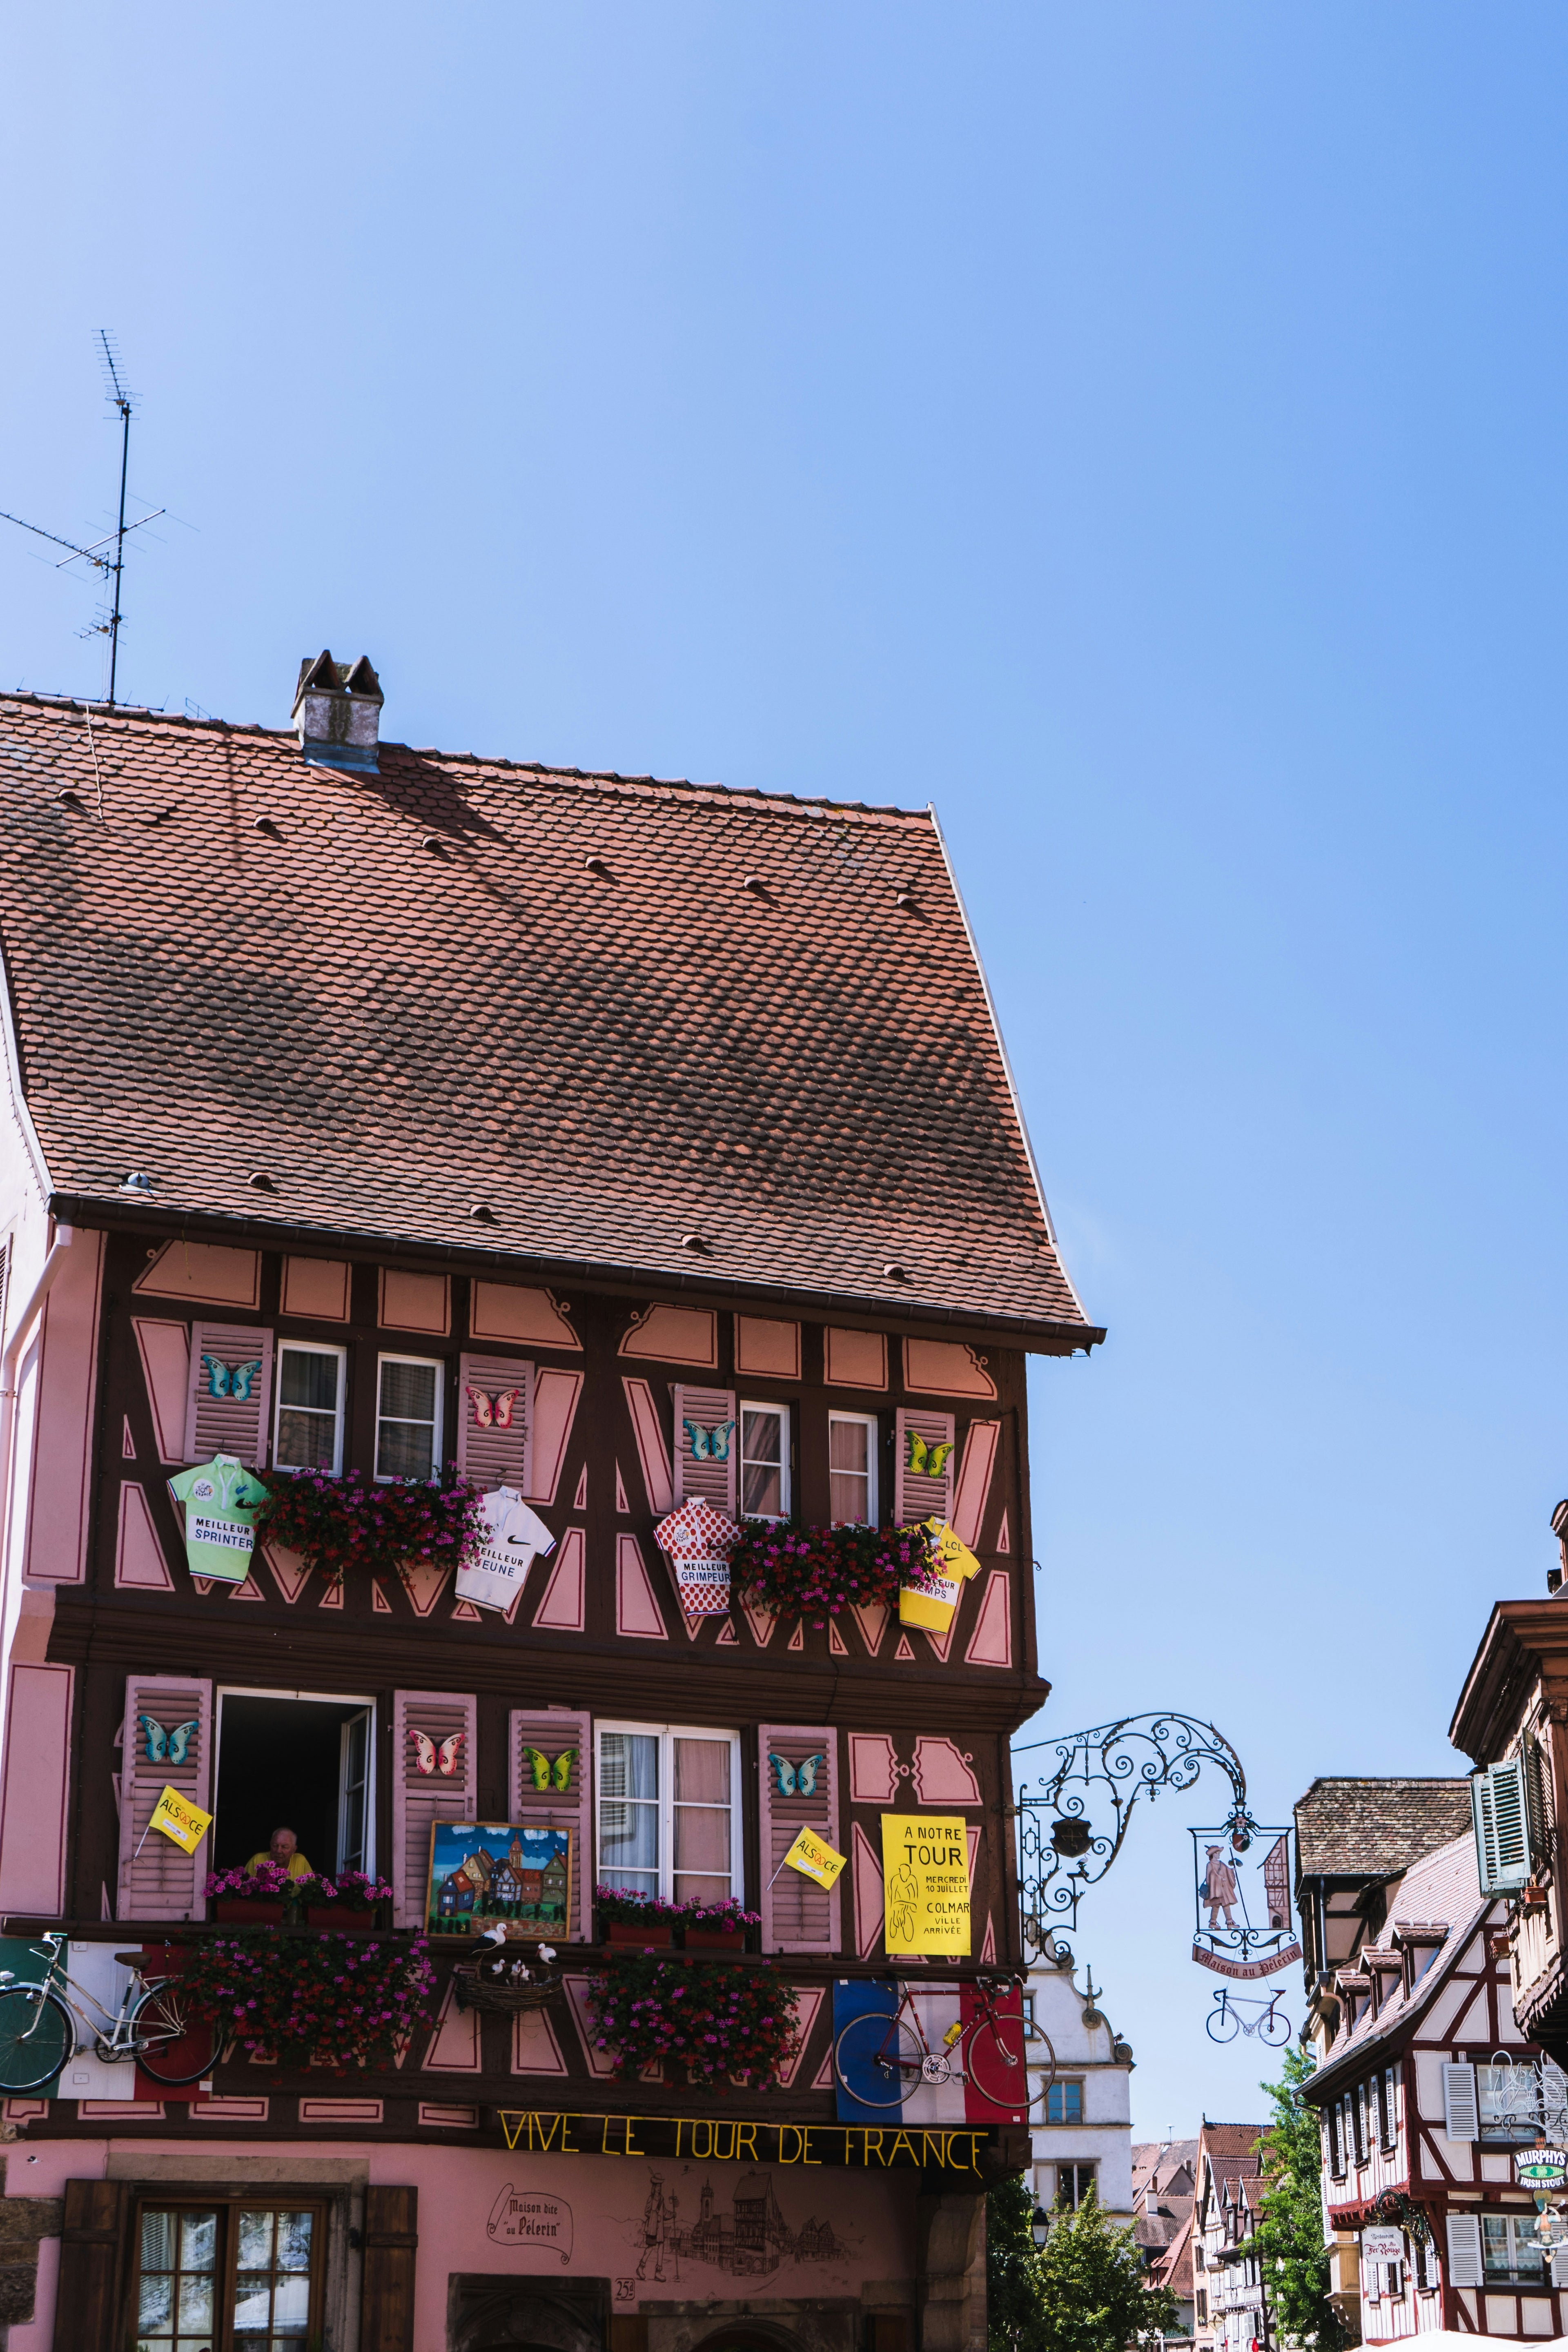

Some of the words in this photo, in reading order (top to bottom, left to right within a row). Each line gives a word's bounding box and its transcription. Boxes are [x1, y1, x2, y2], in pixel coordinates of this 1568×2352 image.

[196, 1518, 250, 1535] MEILLEUR
[195, 1529, 253, 1549] SPRINTER
[946, 1541, 962, 1552] LCL
[682, 1572, 731, 1583] GRIMPEUR
[160, 1799, 203, 1835] ALSACE
[905, 1826, 913, 1838] A
[918, 1827, 962, 1840] NOTRE
[796, 1840, 839, 1873] ALSACE
[904, 1845, 964, 1866] TOUR
[927, 1903, 969, 1913] COLMAR
[1199, 1953, 1238, 1976] Maison
[1243, 1968, 1256, 1976] au
[1258, 1950, 1298, 1975] Pélerin
[500, 2111, 579, 2152] VIVE
[602, 2115, 645, 2155] LE
[669, 2118, 759, 2161] TOUR
[779, 2125, 822, 2164] DE
[845, 2127, 989, 2179] FRANCE
[1515, 2149, 1566, 2167] MURPHY'S
[1520, 2176, 1541, 2188] IRISH
[1541, 2176, 1565, 2188] STOUT
[510, 2199, 541, 2216] Maison
[544, 2203, 558, 2214] dite
[1364, 2243, 1379, 2256] Fer
[1378, 2243, 1401, 2256] Rouge
